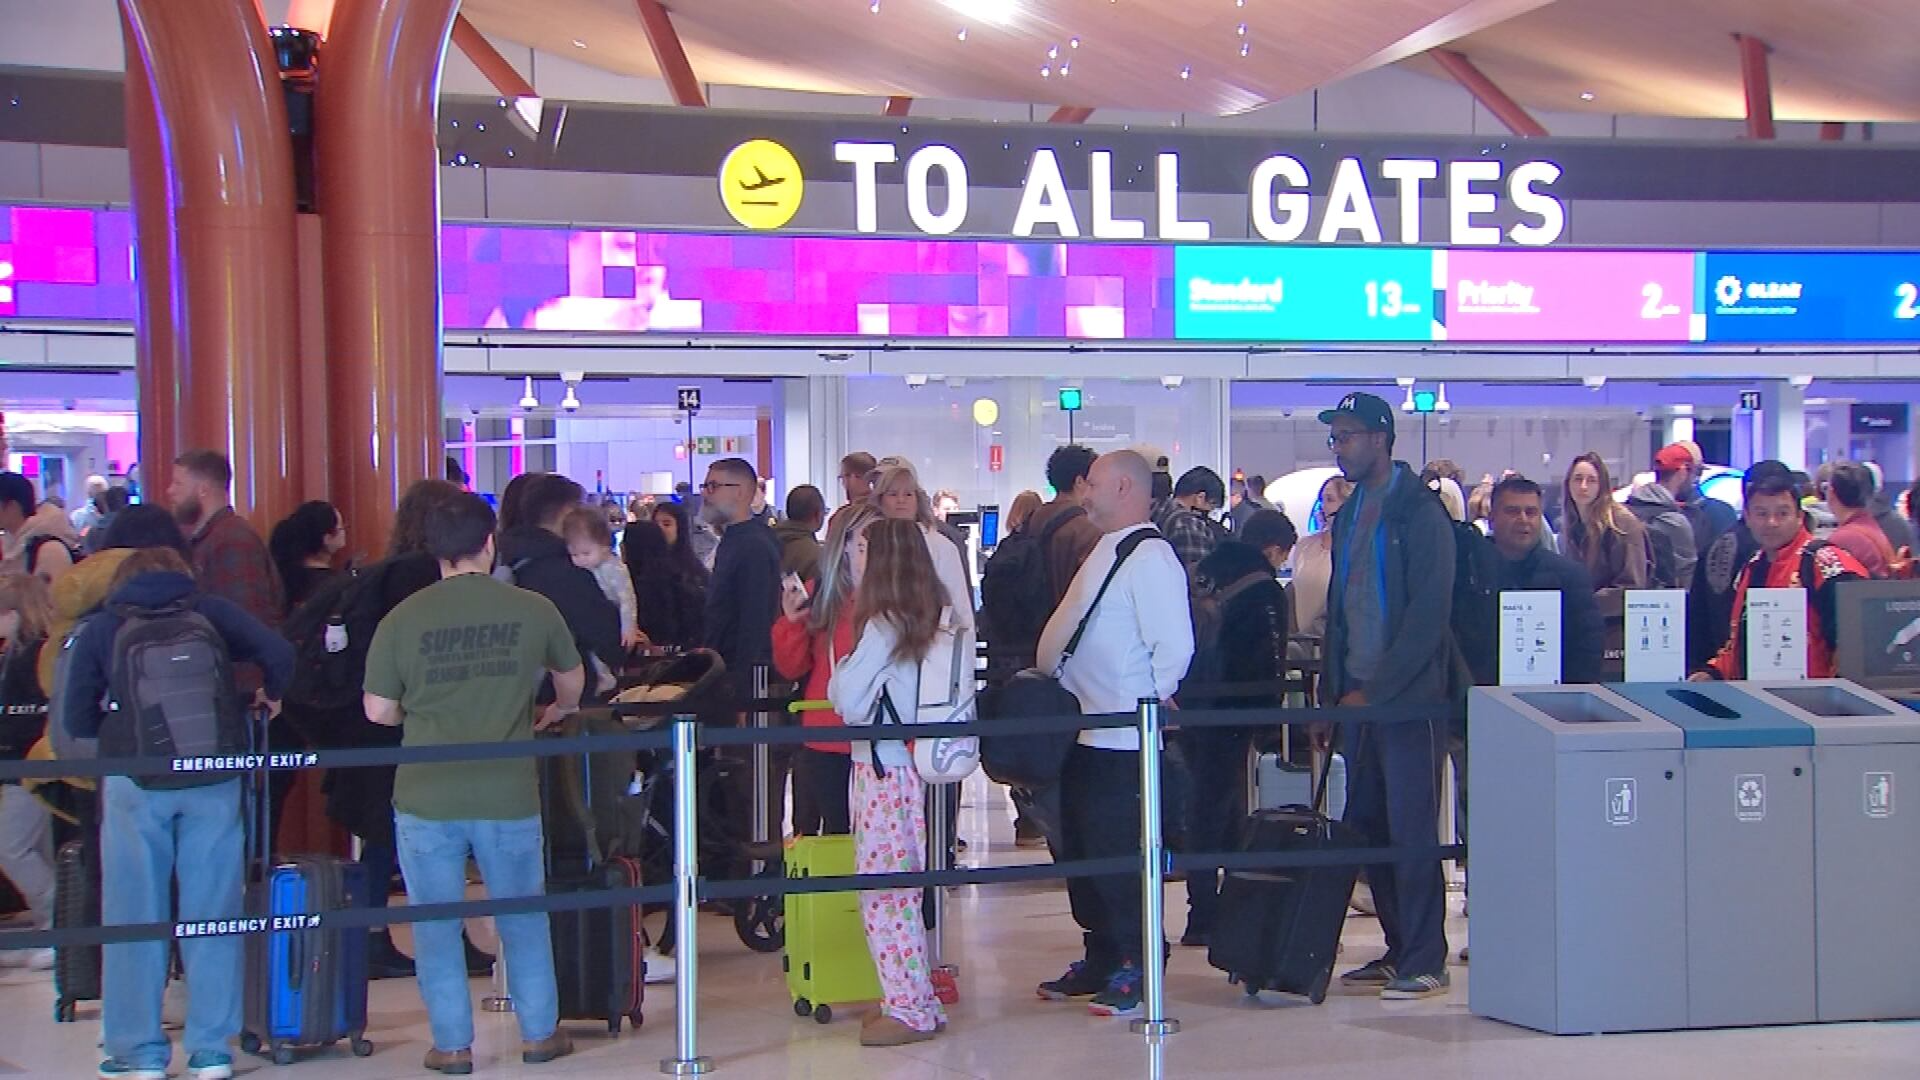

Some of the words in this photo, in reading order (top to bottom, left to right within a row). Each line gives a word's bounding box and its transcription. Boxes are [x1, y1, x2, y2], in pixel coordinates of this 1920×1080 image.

[834, 142, 969, 236] TO
[1012, 149, 1211, 241] ALL
[1251, 154, 1564, 246] GATES
[1365, 281, 1402, 317] 13
[1457, 279, 1535, 309] Priority
[1640, 282, 1663, 318] 2
[1894, 282, 1919, 319] 2
[680, 391, 699, 407] 14
[1741, 391, 1758, 409] 11
[419, 622, 522, 656] SUPREME
[172, 755, 265, 771] EMERGENCY
[269, 753, 304, 767] EXIT
[175, 918, 268, 937] EMERGENCY
[272, 915, 306, 929] EXIT
